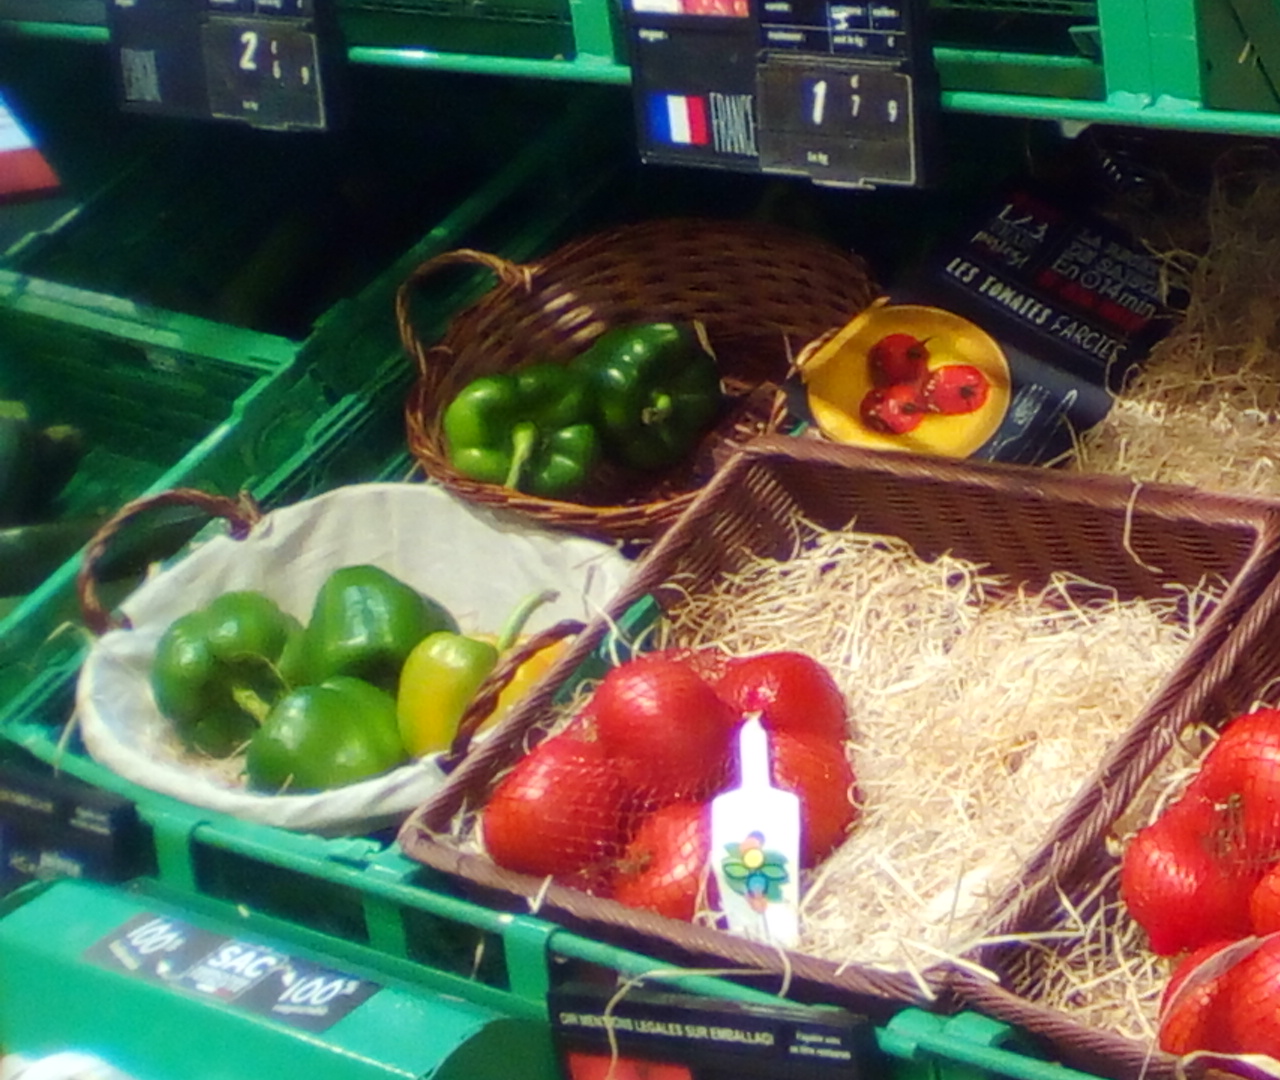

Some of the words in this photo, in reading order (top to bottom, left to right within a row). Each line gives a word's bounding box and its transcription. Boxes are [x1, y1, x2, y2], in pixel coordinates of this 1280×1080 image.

[945, 256, 978, 285] LES
[978, 275, 1055, 326] TOMATES
[1051, 313, 1129, 362] FARCIES
[207, 944, 277, 978] SAC
[635, 1020, 684, 1038] LEGALES
[685, 1023, 709, 1040] SUR
